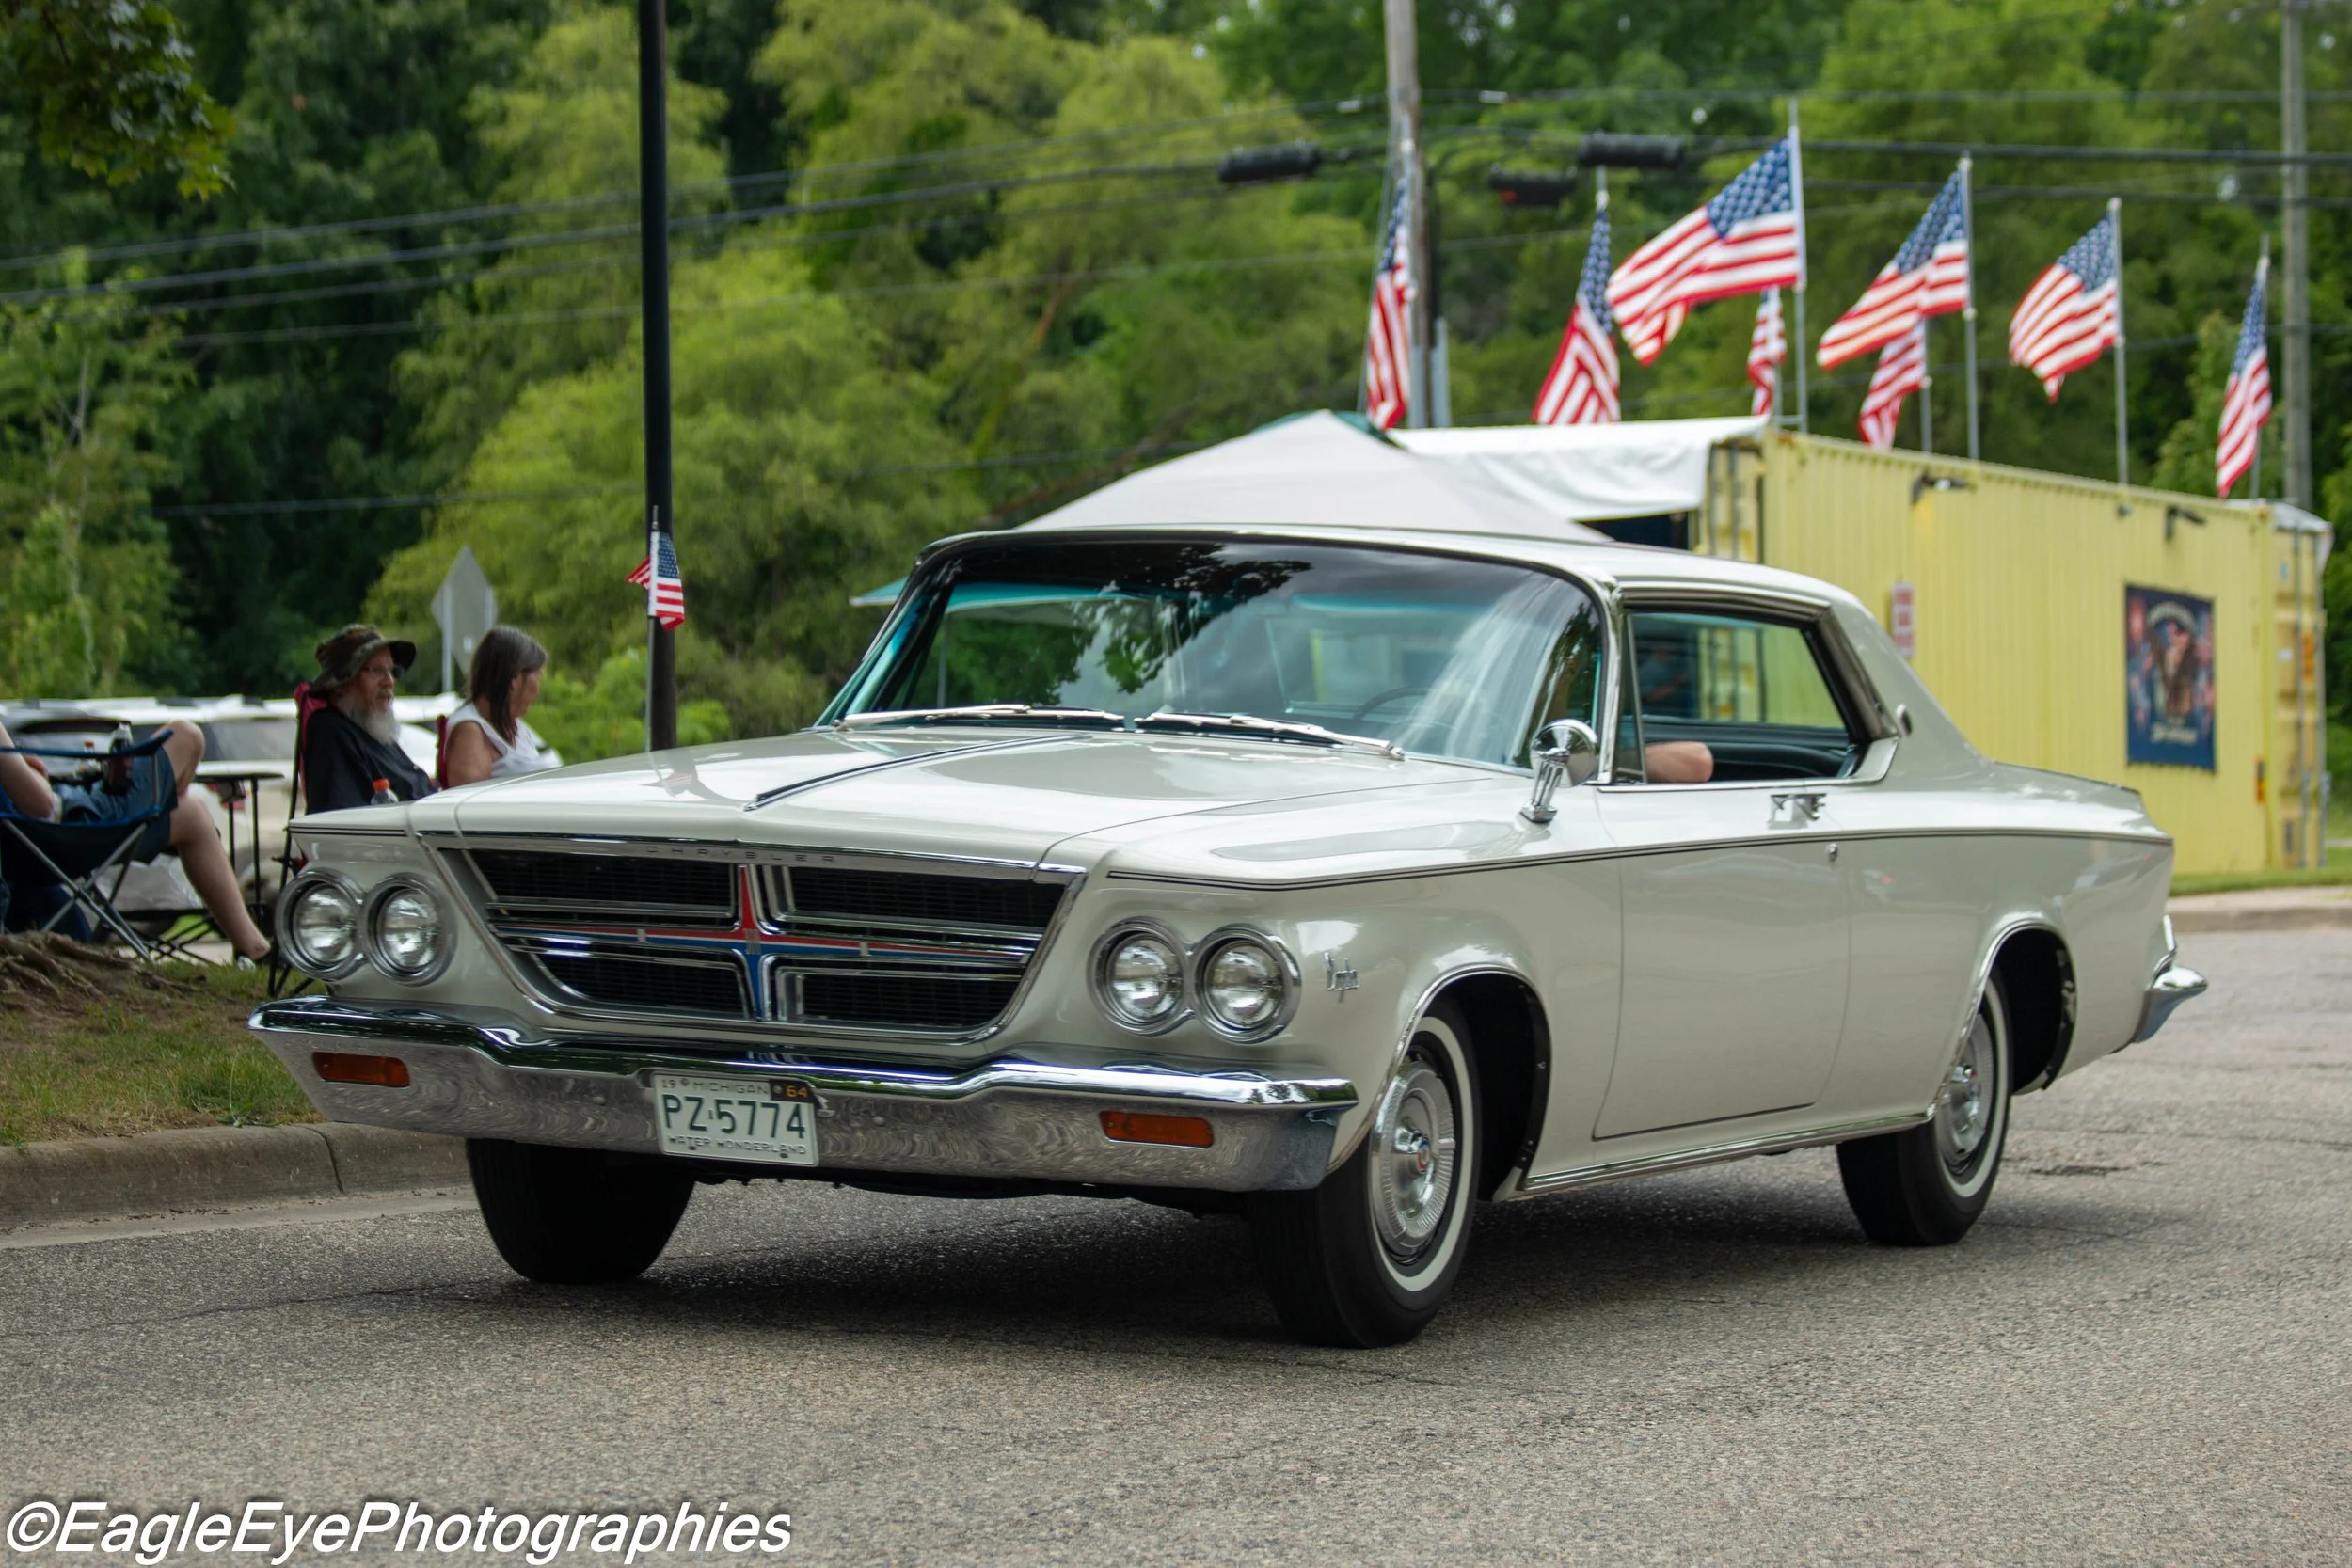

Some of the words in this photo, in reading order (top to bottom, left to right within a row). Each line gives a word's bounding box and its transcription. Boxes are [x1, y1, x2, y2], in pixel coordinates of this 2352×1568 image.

[645, 846, 834, 863] CHRYSLER
[692, 1082, 770, 1095] MICHIGAN
[785, 1085, 808, 1099] 64
[668, 1134, 711, 1148] WATER
[717, 1140, 807, 1155] WONDERLAND
